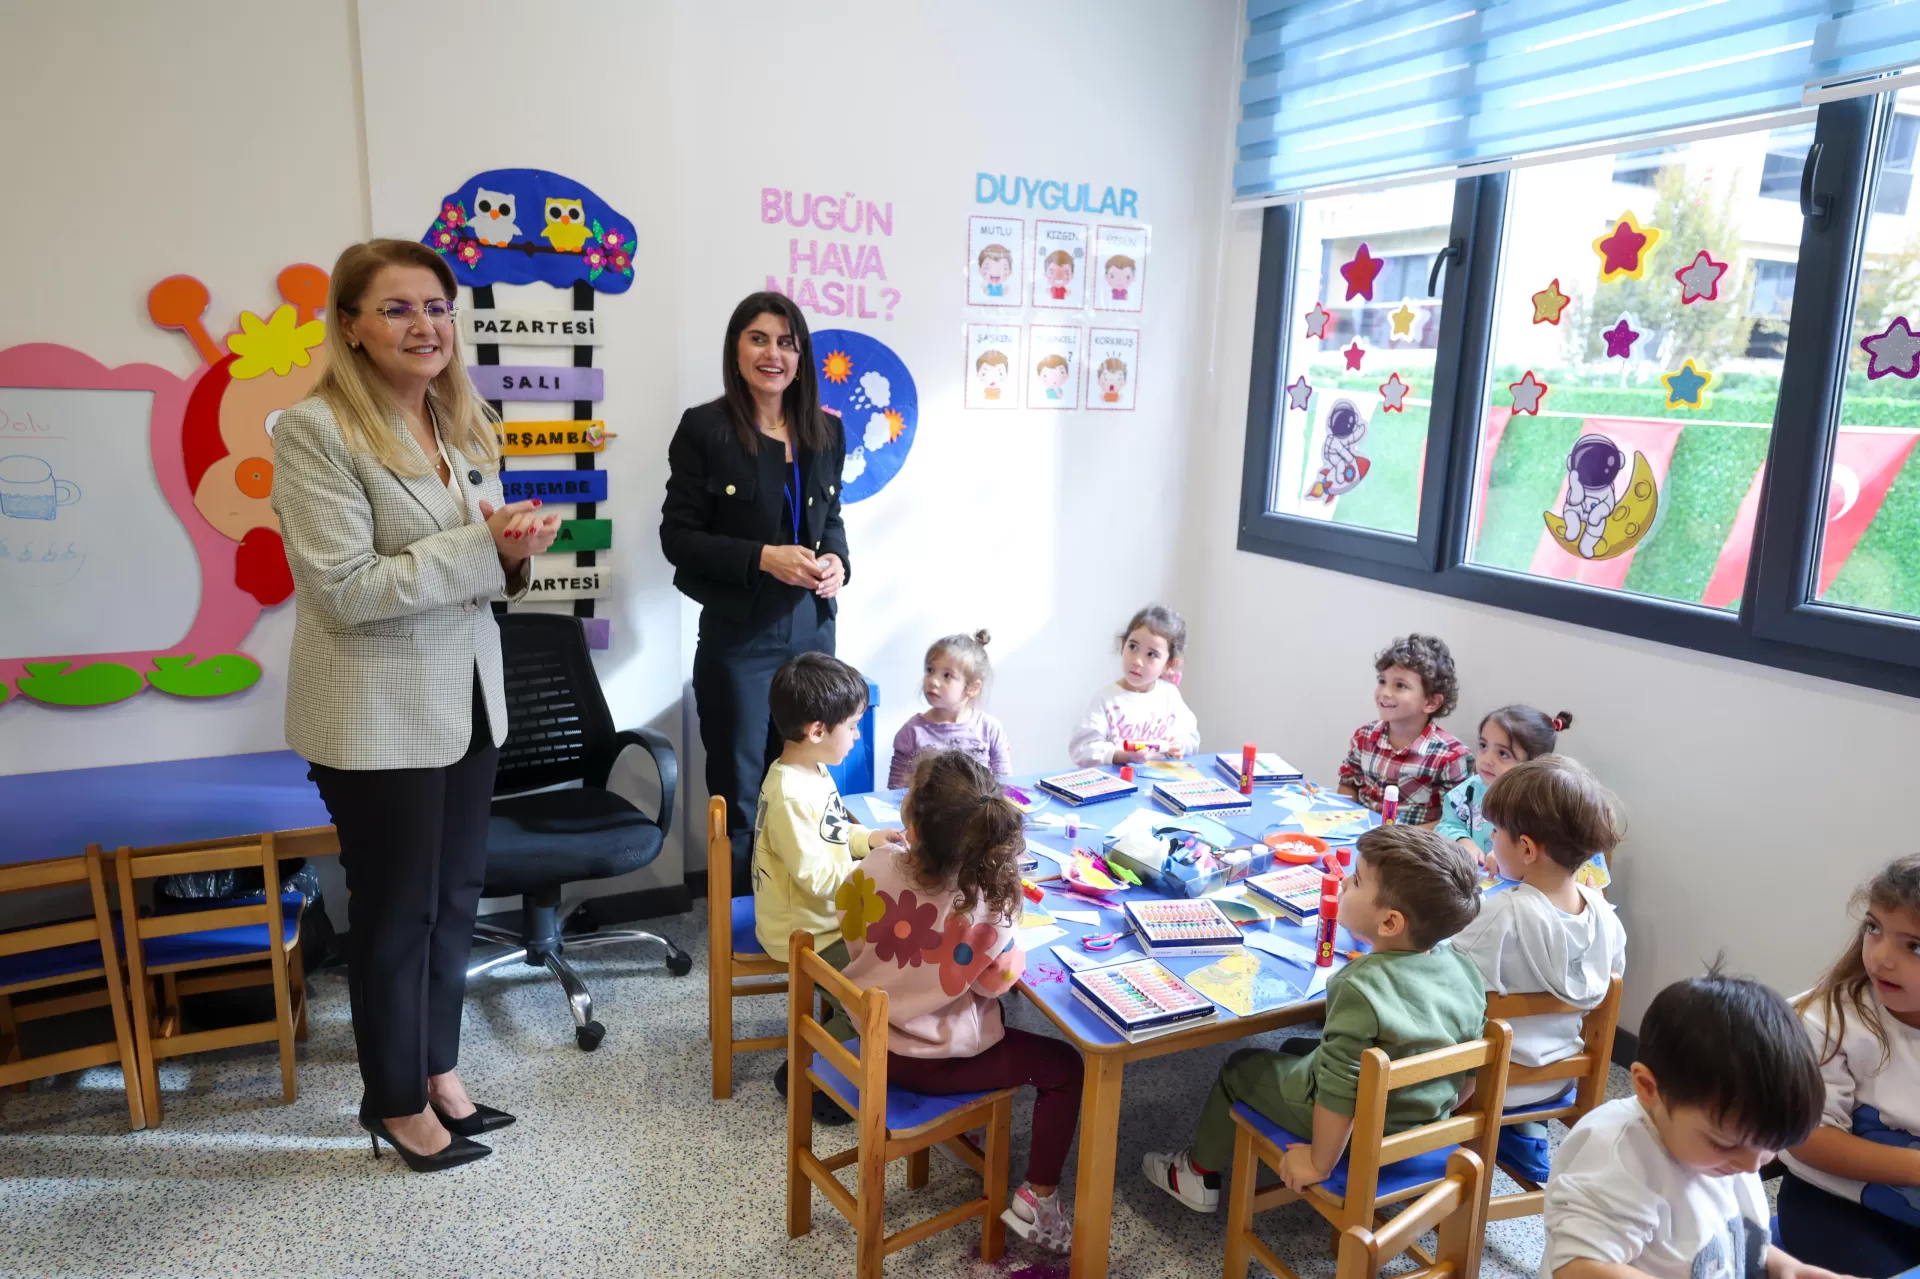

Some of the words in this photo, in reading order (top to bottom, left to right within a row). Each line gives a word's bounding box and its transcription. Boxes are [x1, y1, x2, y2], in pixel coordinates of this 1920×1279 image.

[976, 172, 1138, 219] DUYGULAR
[761, 187, 893, 236] BUGÜN
[980, 225, 1012, 236] MUTLU
[790, 238, 888, 281] HAVA
[766, 275, 901, 321] NASIL?
[474, 317, 595, 334] PAZARTESİ
[502, 375, 560, 389] SALI
[503, 480, 591, 498] ERŞEMBE
[530, 573, 599, 591] ARTESİ
